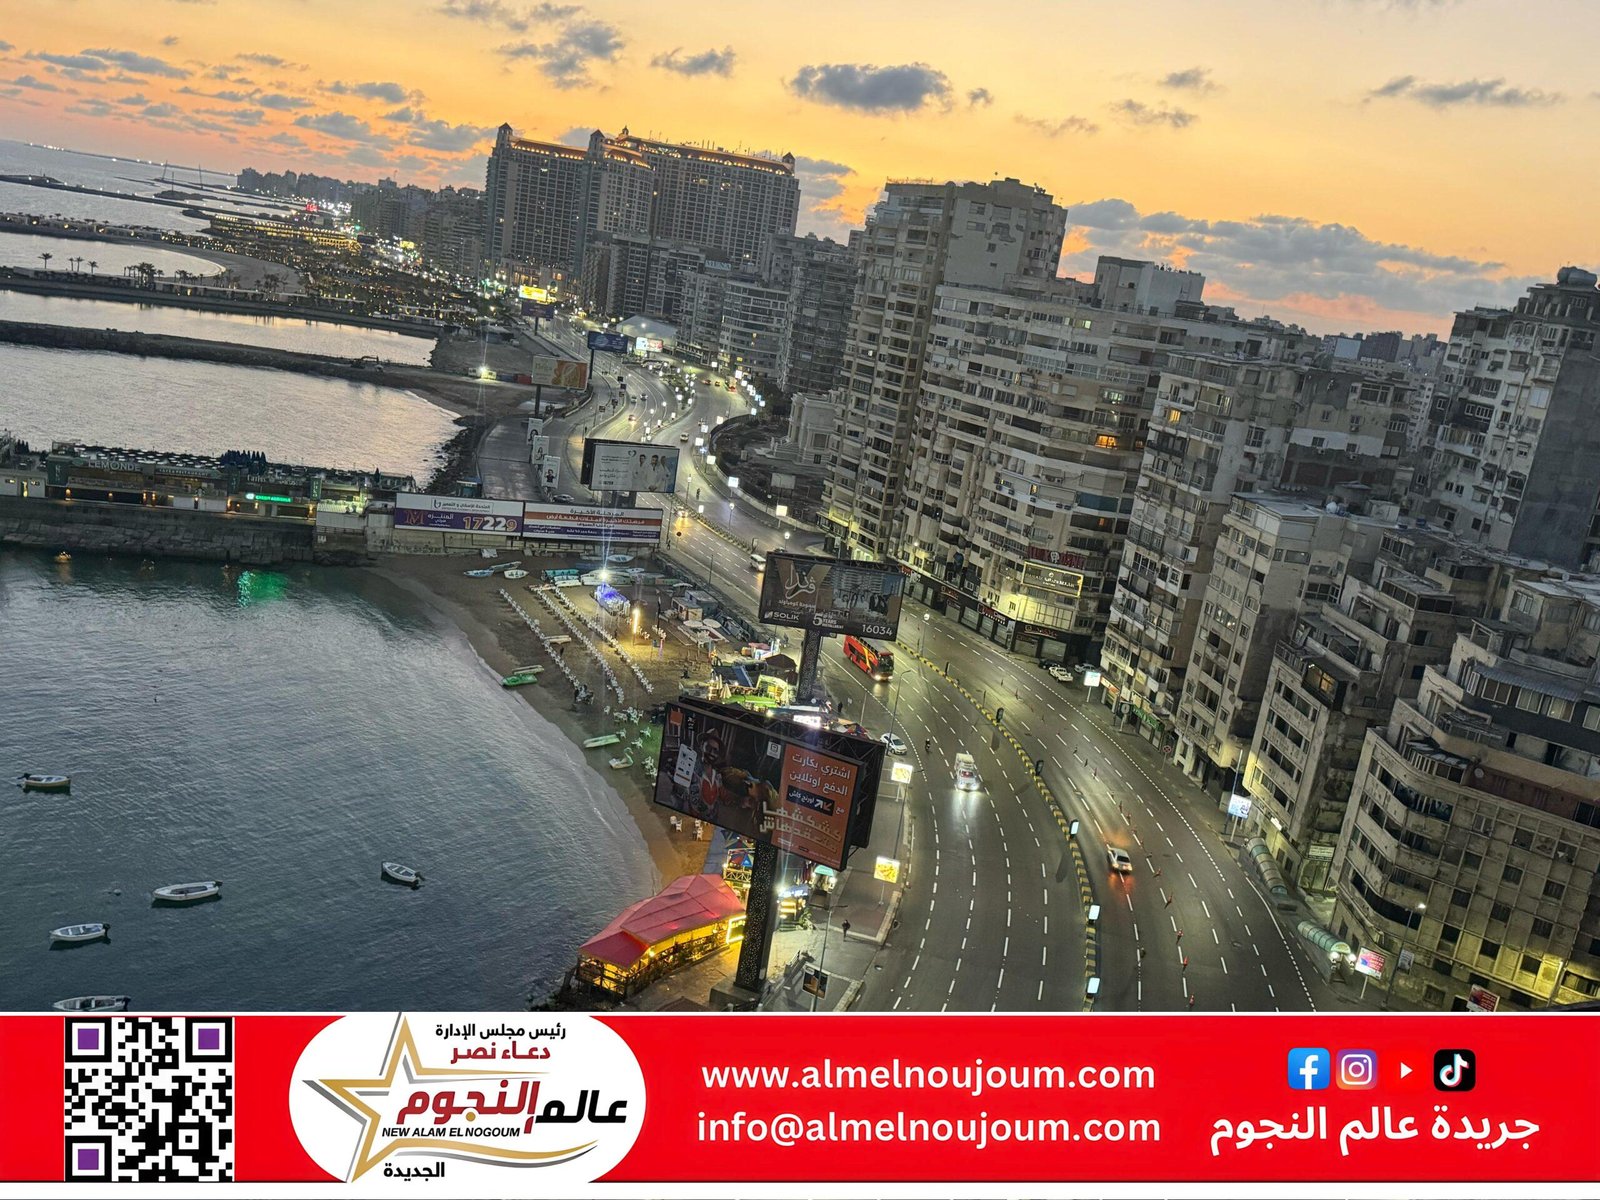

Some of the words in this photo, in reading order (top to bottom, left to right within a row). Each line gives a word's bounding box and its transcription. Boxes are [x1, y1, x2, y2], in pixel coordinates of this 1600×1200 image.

[463, 516, 518, 532] 17229
[773, 611, 800, 621] SOLIK
[812, 612, 823, 626] 5
[862, 624, 893, 636] 16034
[792, 753, 819, 771] بكارت
[789, 770, 821, 788] اونلاين
[821, 766, 851, 779] اشتري
[822, 782, 848, 796] الدفع
[835, 806, 845, 815] مع
